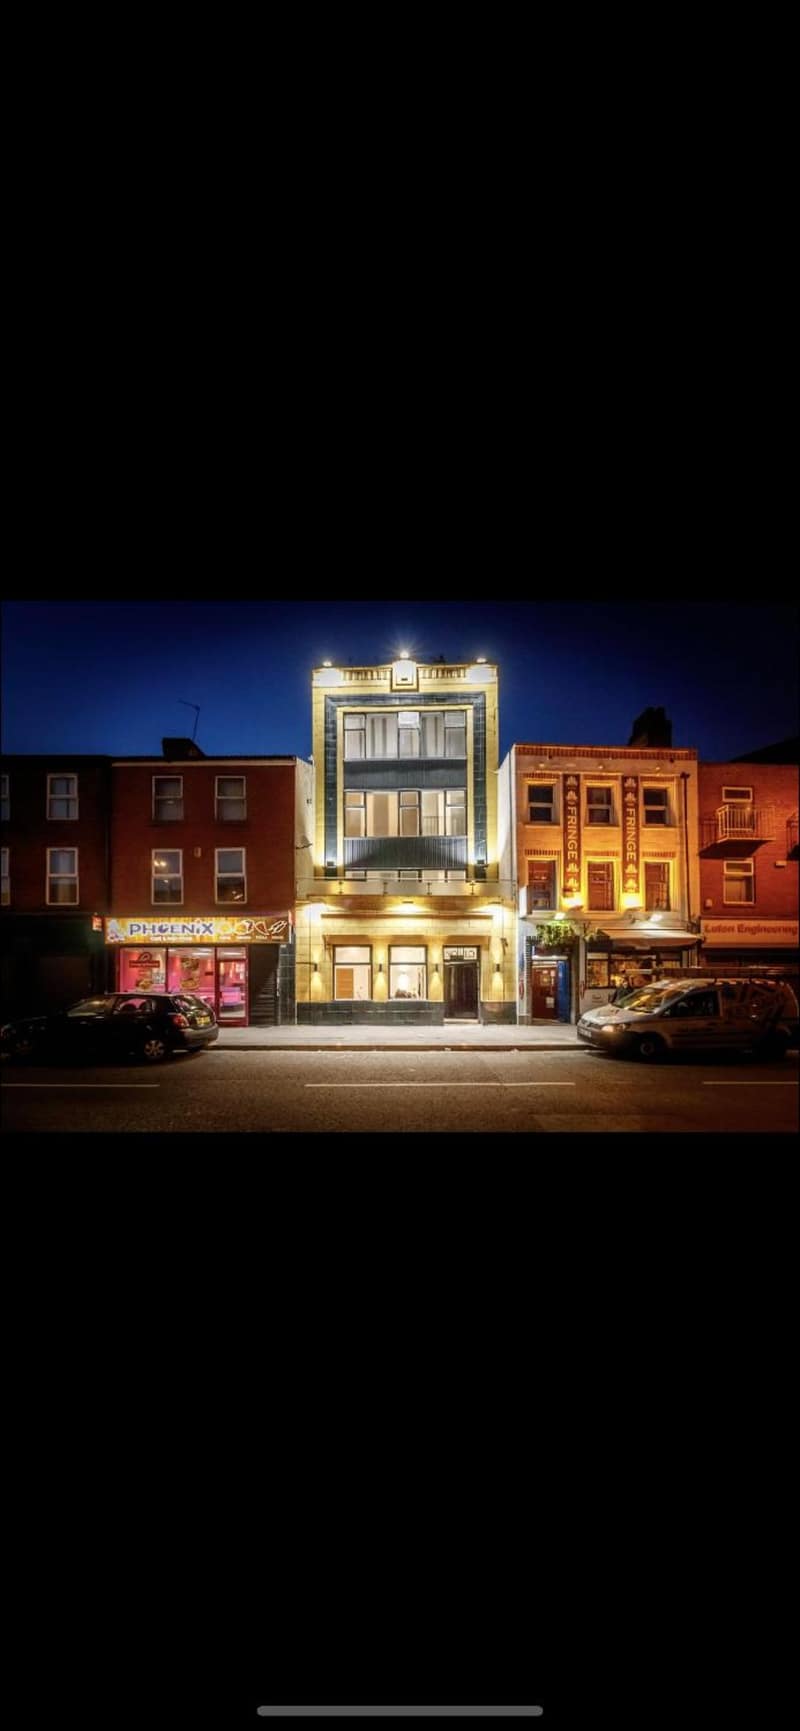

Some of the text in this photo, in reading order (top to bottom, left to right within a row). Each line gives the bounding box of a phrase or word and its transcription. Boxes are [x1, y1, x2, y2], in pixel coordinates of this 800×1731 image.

[567, 806, 578, 860] FRINGE
[626, 808, 637, 862] FRINGE
[737, 923, 798, 936] Engineering
